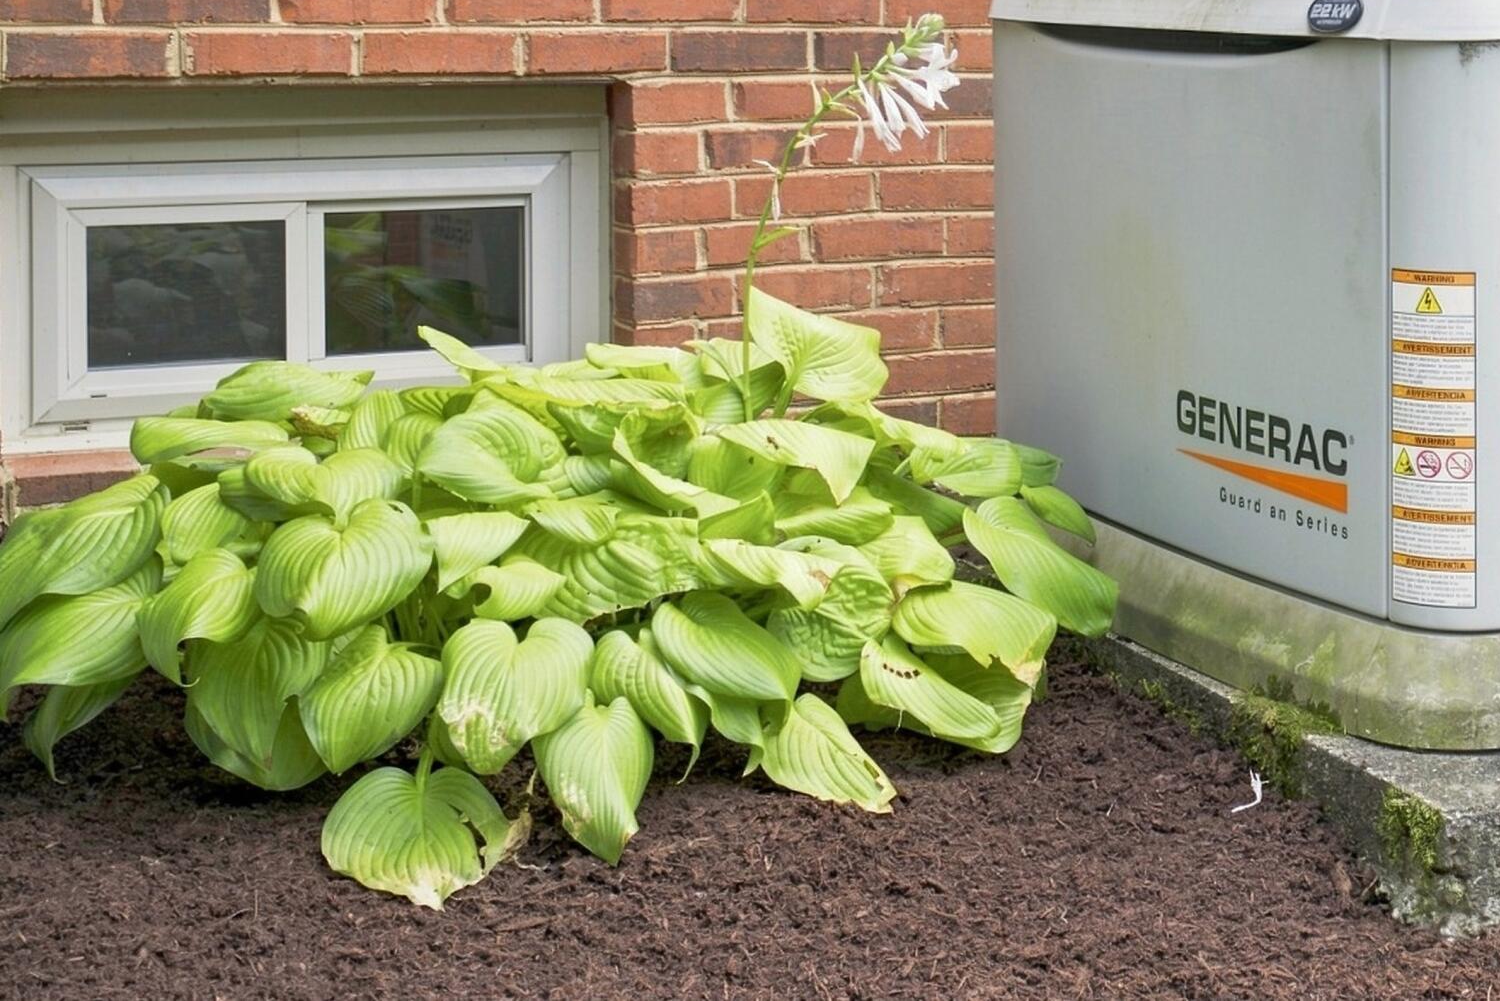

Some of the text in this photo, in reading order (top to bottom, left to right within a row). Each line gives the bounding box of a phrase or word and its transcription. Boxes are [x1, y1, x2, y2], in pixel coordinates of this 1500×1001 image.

[1414, 274, 1455, 283] WARNING
[1402, 343, 1472, 355] AVERTISSEMENT
[1405, 387, 1466, 399] ADVERTENCIA
[1176, 389, 1348, 477] GENERAC
[1414, 436, 1456, 447] WARNING
[1402, 510, 1473, 523] AVERTISSEMENT
[1296, 509, 1349, 539] Series
[1406, 557, 1466, 569] ADVERTENCIA
